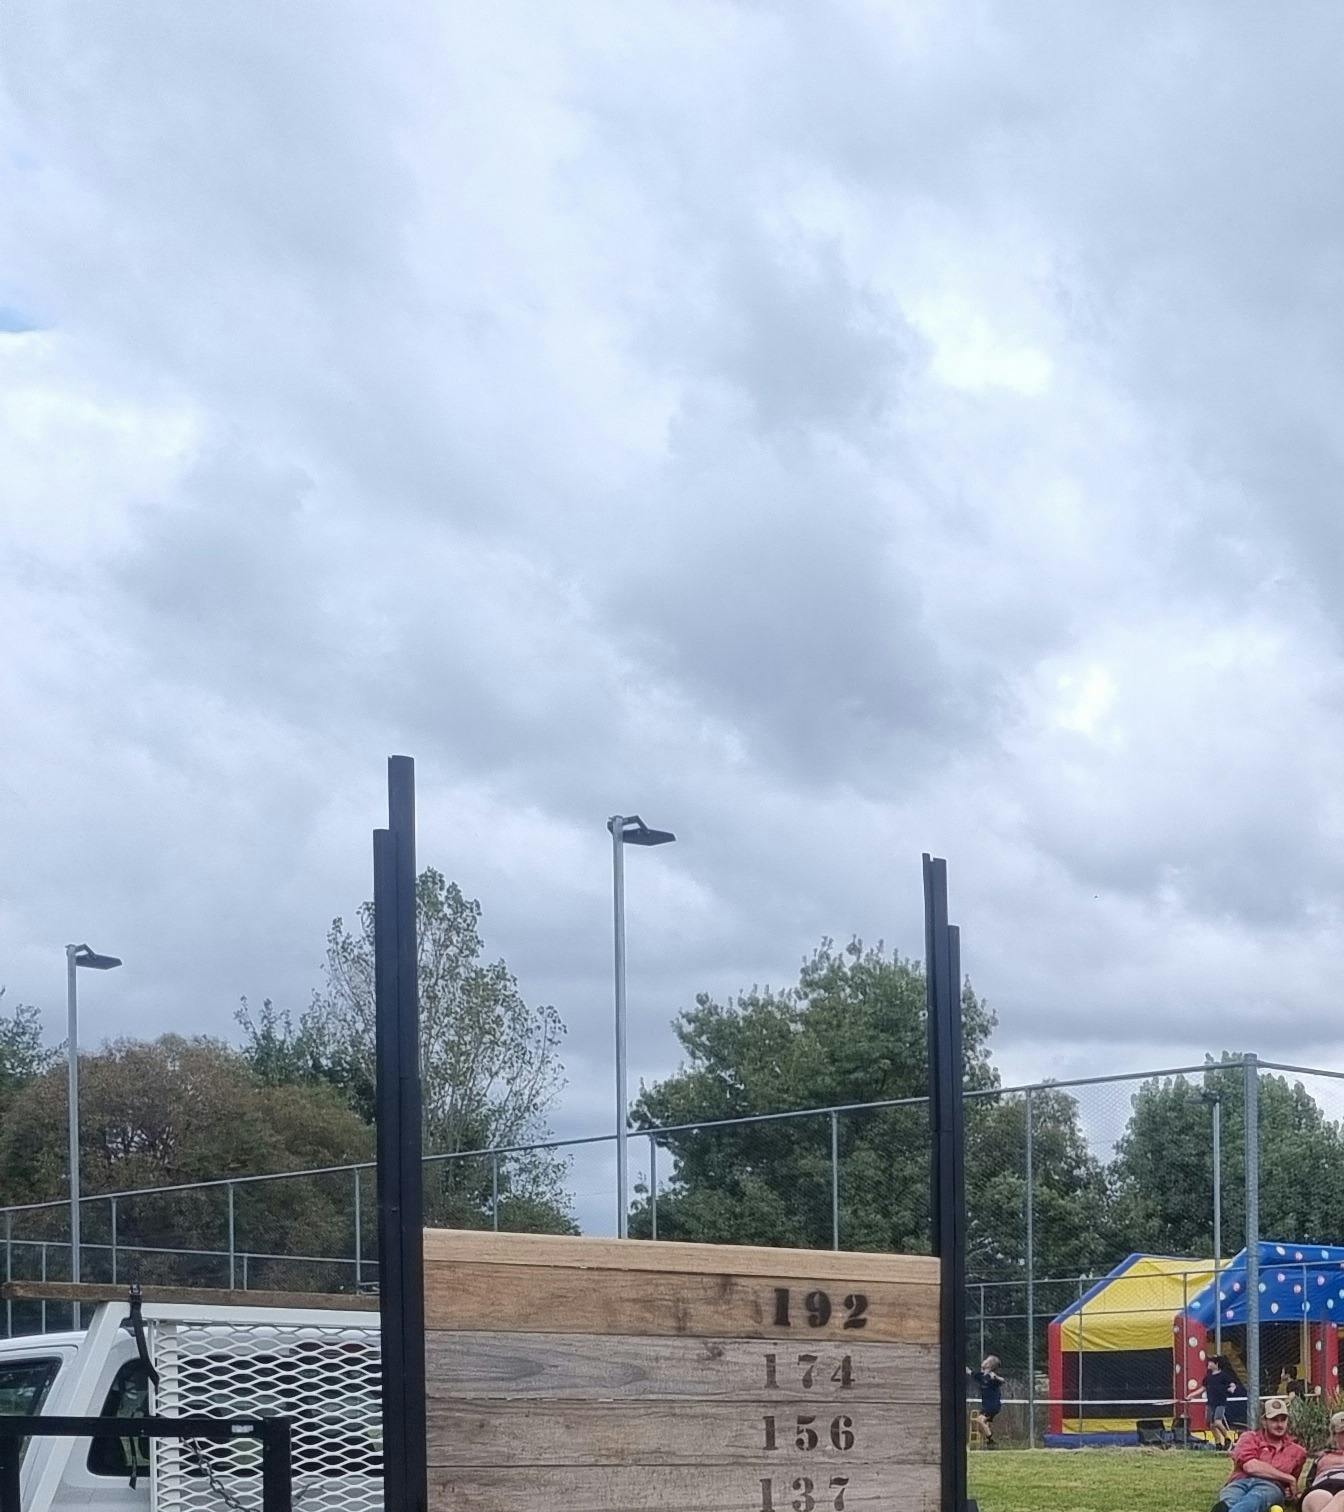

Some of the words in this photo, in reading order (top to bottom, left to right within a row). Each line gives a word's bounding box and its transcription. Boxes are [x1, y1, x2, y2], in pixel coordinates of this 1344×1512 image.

[773, 1288, 868, 1330] 192
[763, 1353, 856, 1390] 174
[762, 1415, 855, 1451] 156
[759, 1477, 849, 1512] 137
